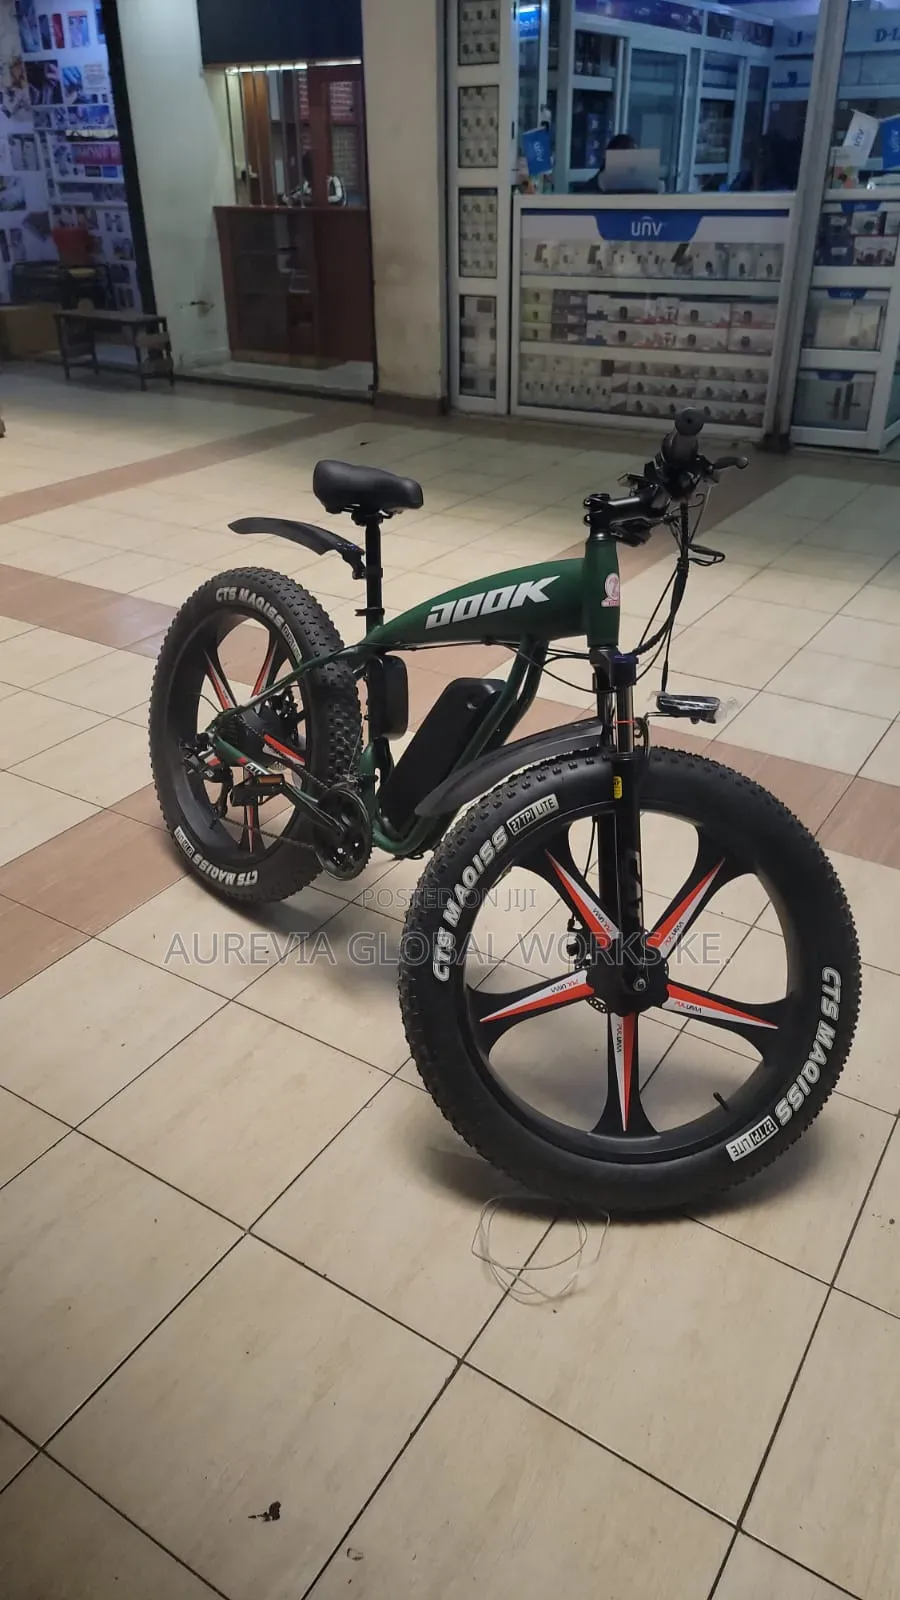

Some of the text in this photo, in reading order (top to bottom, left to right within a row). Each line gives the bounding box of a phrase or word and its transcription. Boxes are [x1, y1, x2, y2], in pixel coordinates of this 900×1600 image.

[216, 586, 284, 627] CTS MAQISS
[237, 869, 258, 886] CTS
[432, 926, 451, 981] CTS
[442, 825, 509, 928] MAQISS
[535, 797, 556, 816] LITE
[821, 966, 842, 1022] CTS
[774, 1019, 836, 1126] MAQISS
[731, 1136, 751, 1158] LITE
